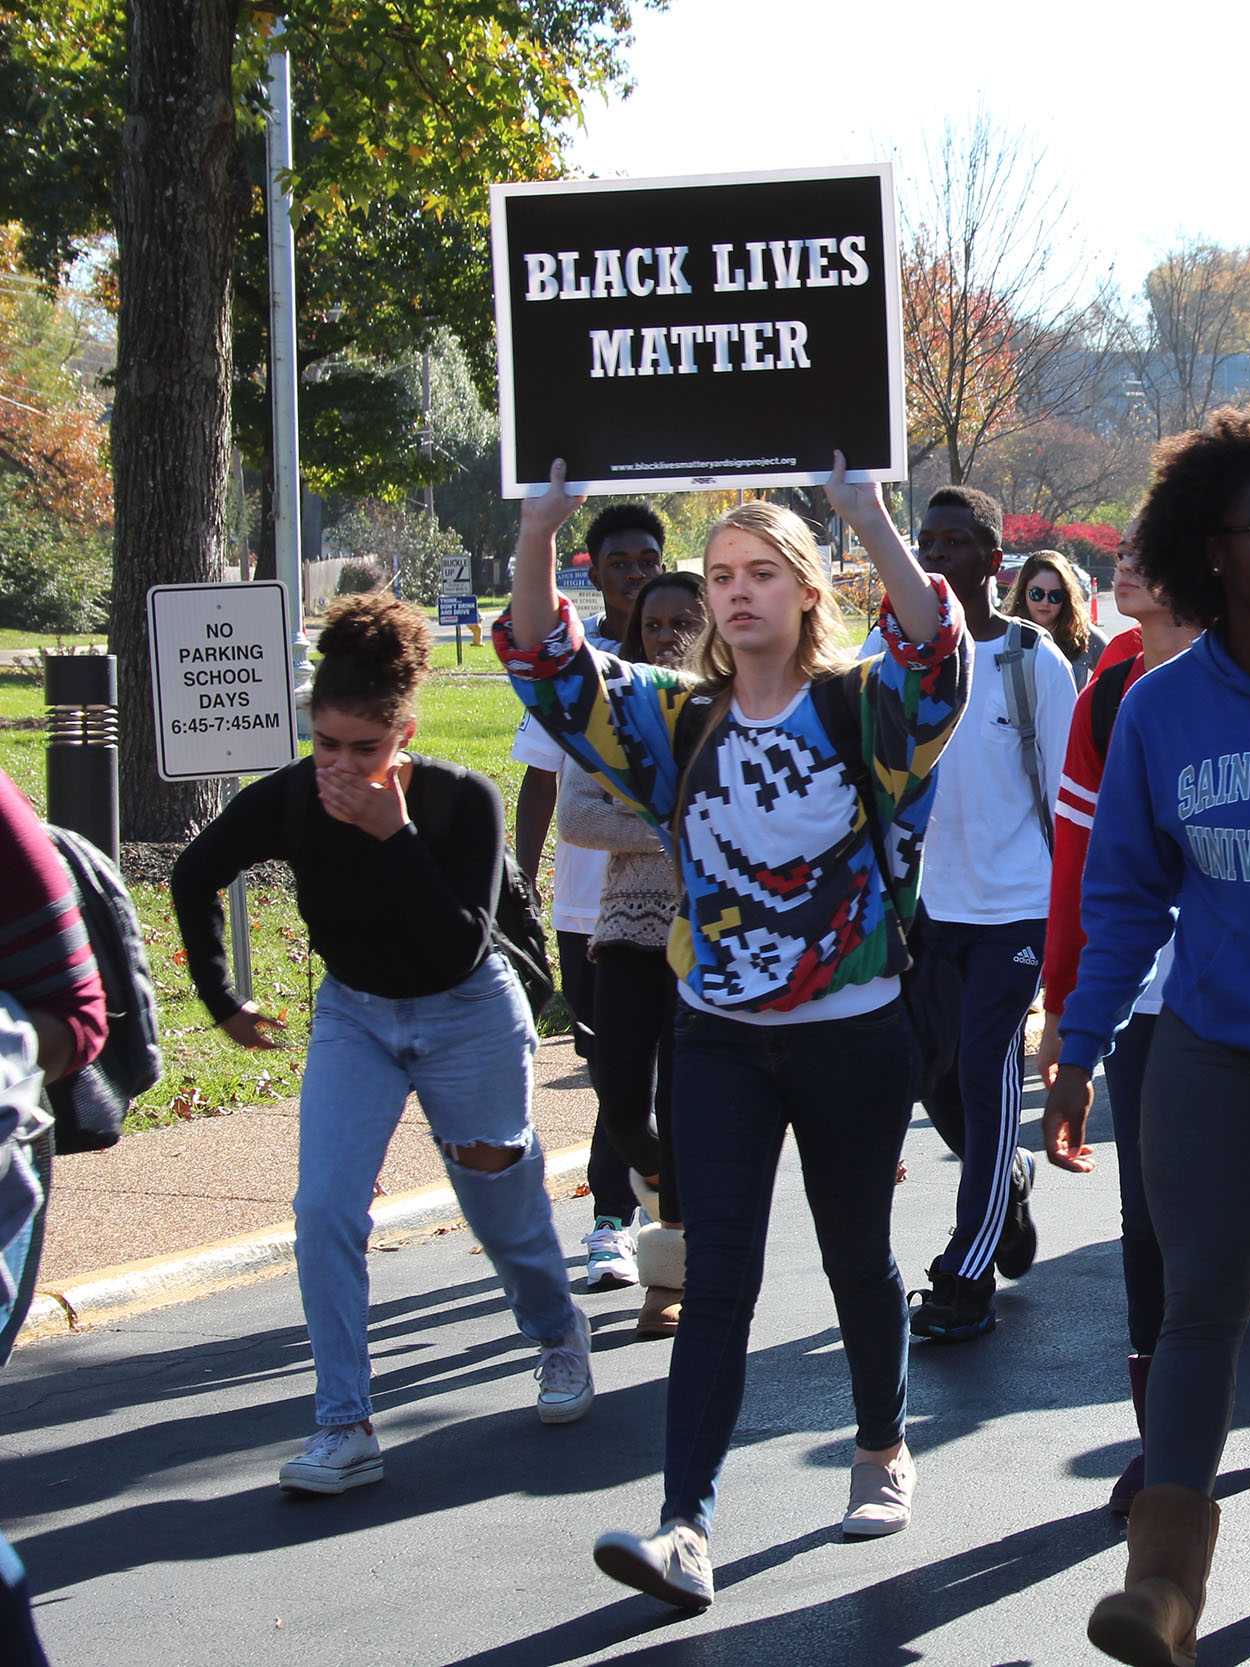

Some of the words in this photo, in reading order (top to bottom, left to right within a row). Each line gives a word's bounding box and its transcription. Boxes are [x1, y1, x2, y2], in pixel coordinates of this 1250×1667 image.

[523, 245, 692, 302] BLACK
[711, 235, 870, 293] LIVES
[589, 320, 812, 379] MATTER
[611, 456, 797, 472] www.blacklivesmatteryardsignproject.org
[206, 622, 233, 639] NO
[179, 644, 264, 663] PARKING
[184, 668, 262, 687] SCHOOL
[200, 691, 250, 709] DAYS
[172, 713, 279, 734] 6:45-7:45AM
[1013, 955, 1039, 966] adidas
